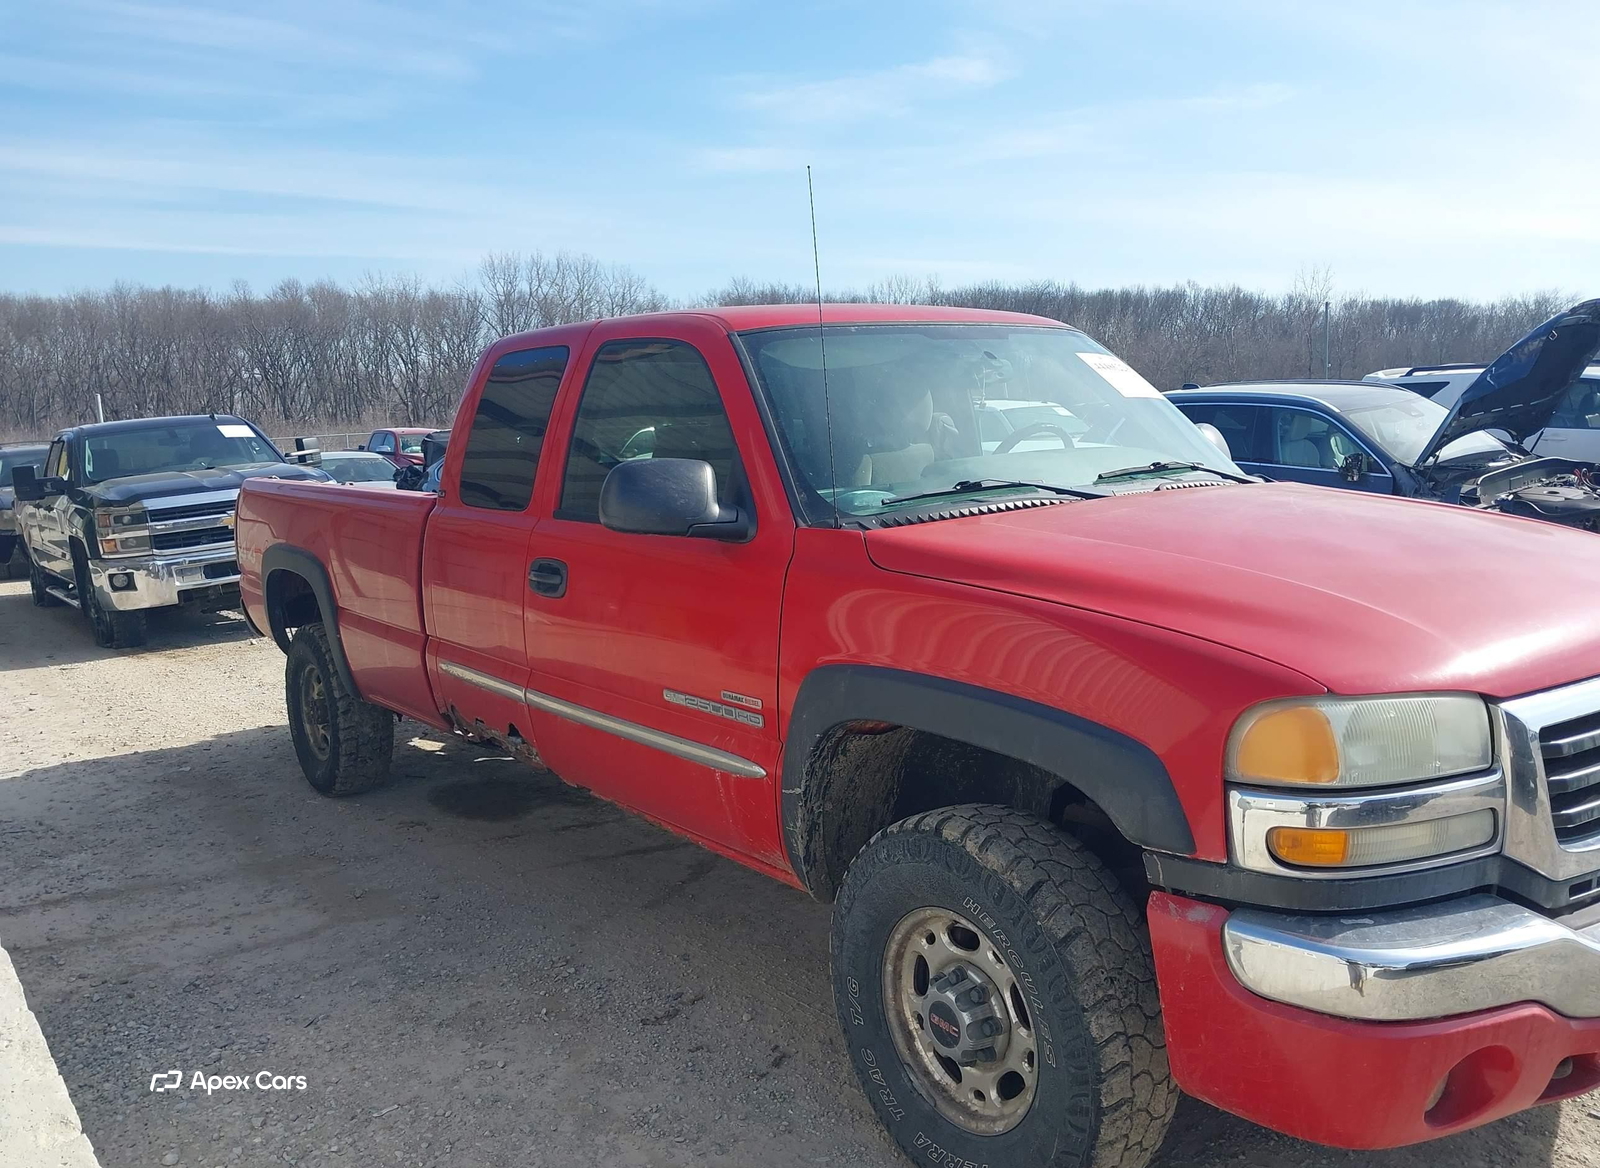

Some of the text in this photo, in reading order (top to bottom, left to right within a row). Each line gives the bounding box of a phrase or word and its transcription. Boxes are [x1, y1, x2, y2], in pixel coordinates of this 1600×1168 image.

[930, 1013, 959, 1037] GMC
[963, 897, 1056, 1068] HERCULES
[846, 976, 988, 1168] ERRA TRAC T/G
